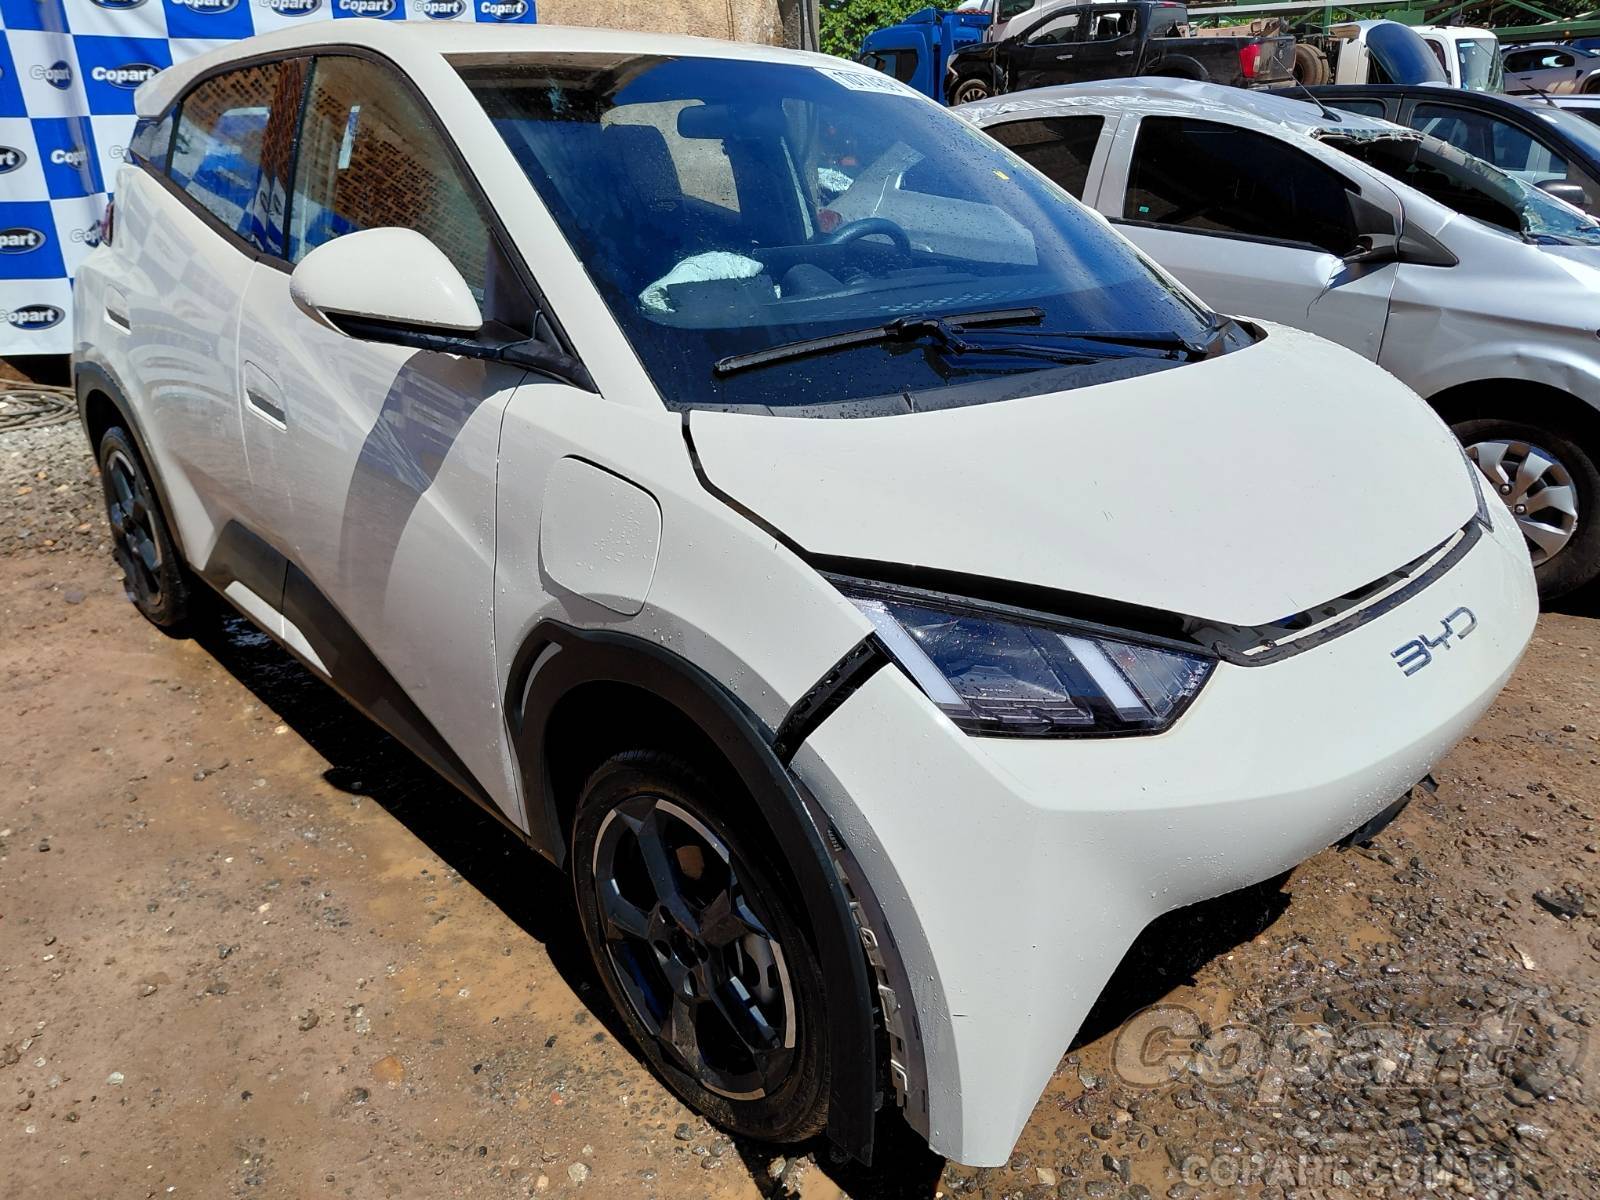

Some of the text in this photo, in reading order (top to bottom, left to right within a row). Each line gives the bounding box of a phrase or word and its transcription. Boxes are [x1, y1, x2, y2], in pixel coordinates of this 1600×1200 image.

[339, 0, 389, 12] Copart
[413, 0, 459, 14] Copart
[480, 1, 523, 15] Copart
[1390, 606, 1478, 677] BYD
